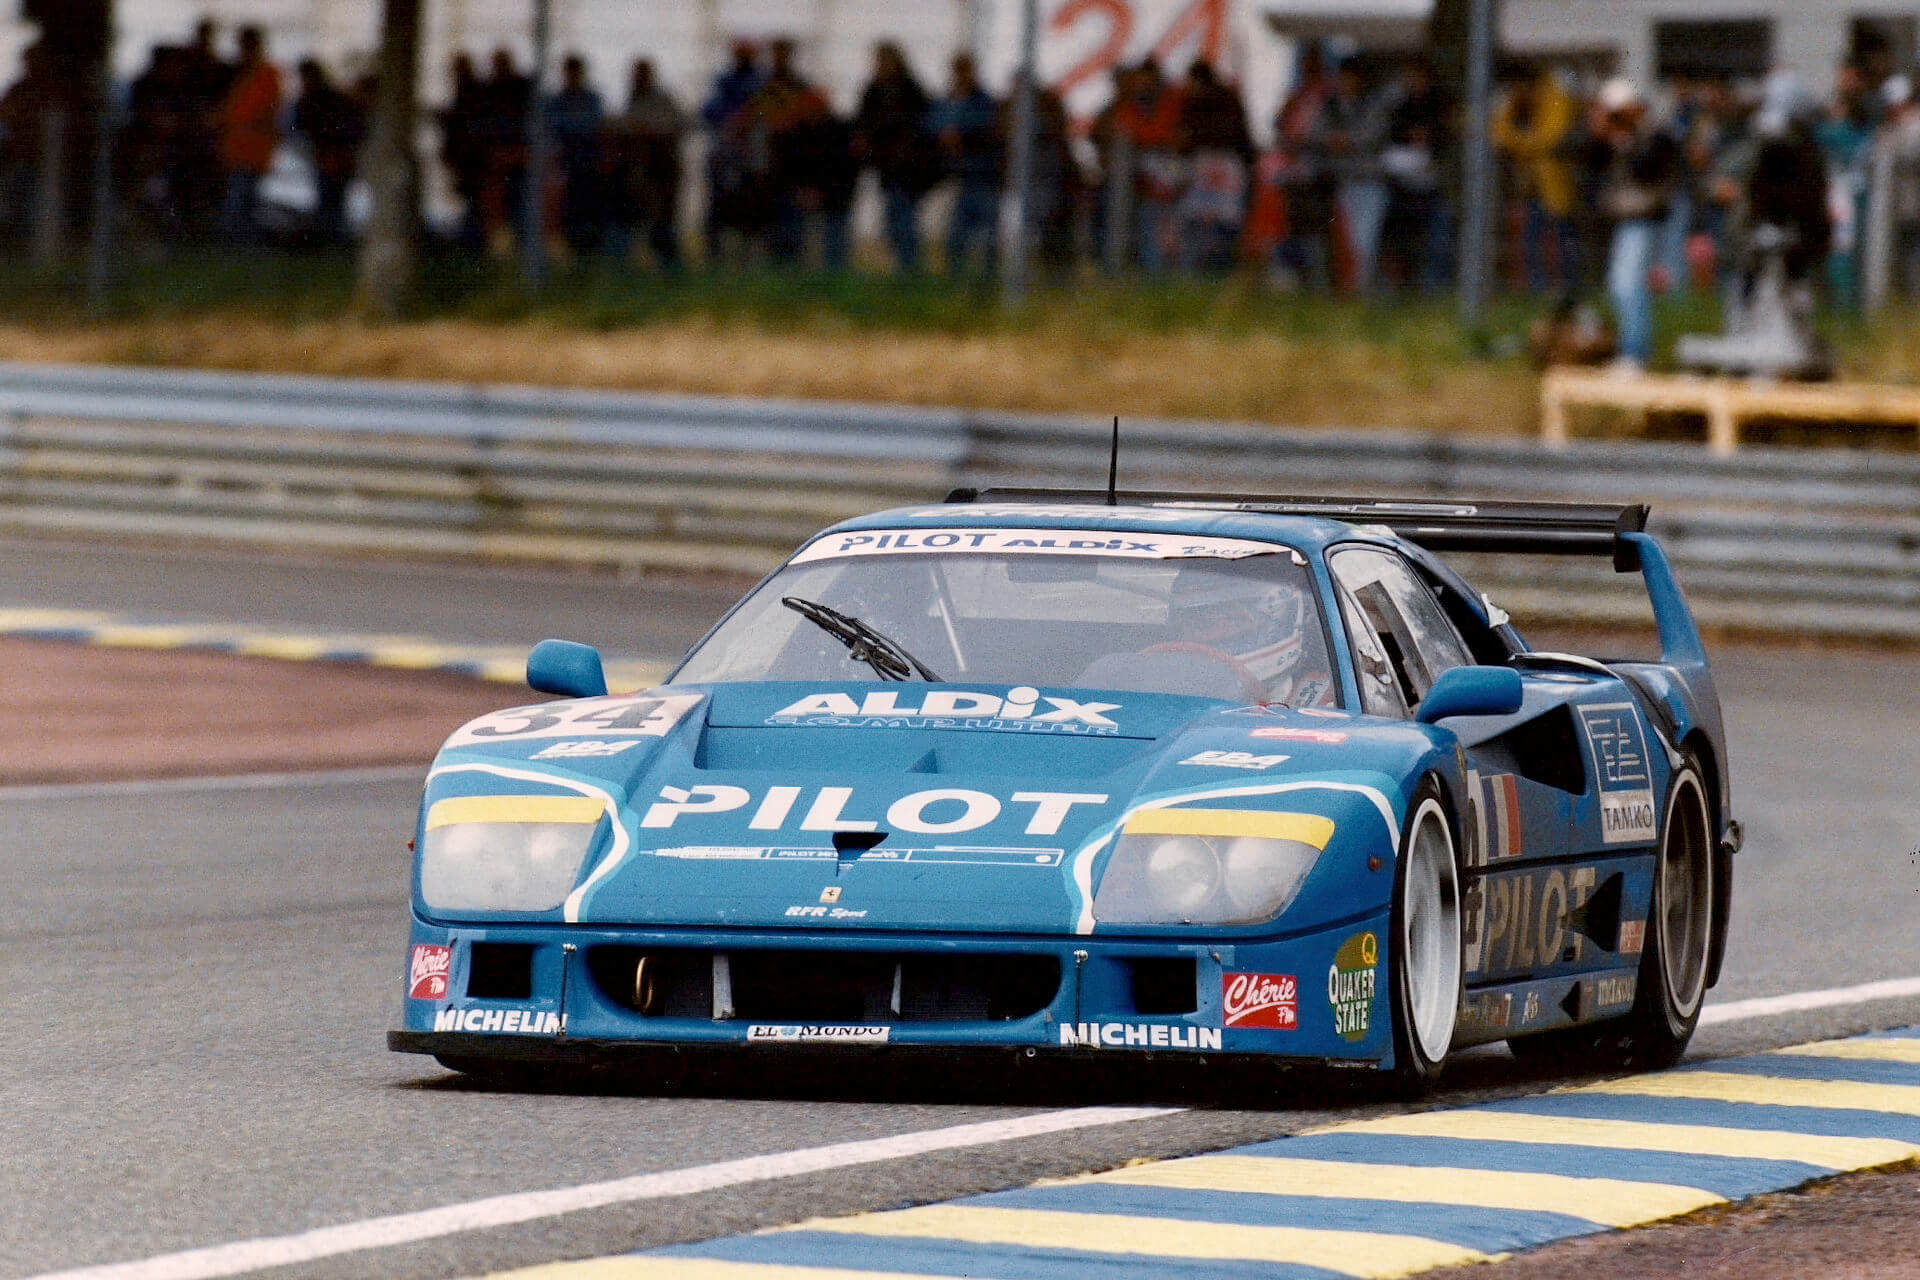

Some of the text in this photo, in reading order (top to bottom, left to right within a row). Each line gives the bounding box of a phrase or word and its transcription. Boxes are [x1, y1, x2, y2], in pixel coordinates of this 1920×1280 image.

[839, 533, 998, 551] PILOT
[471, 700, 669, 737] 34
[641, 785, 1109, 835] PILOT
[1603, 804, 1653, 831] TAMKO
[1224, 975, 1296, 1015] Chérie
[1328, 964, 1376, 1004] QUAKER
[434, 1009, 568, 1034] MICHELIN
[753, 1025, 883, 1037] EL MUNDO
[1335, 1000, 1369, 1035] STATE
[1060, 1022, 1222, 1050] MICHELIN
